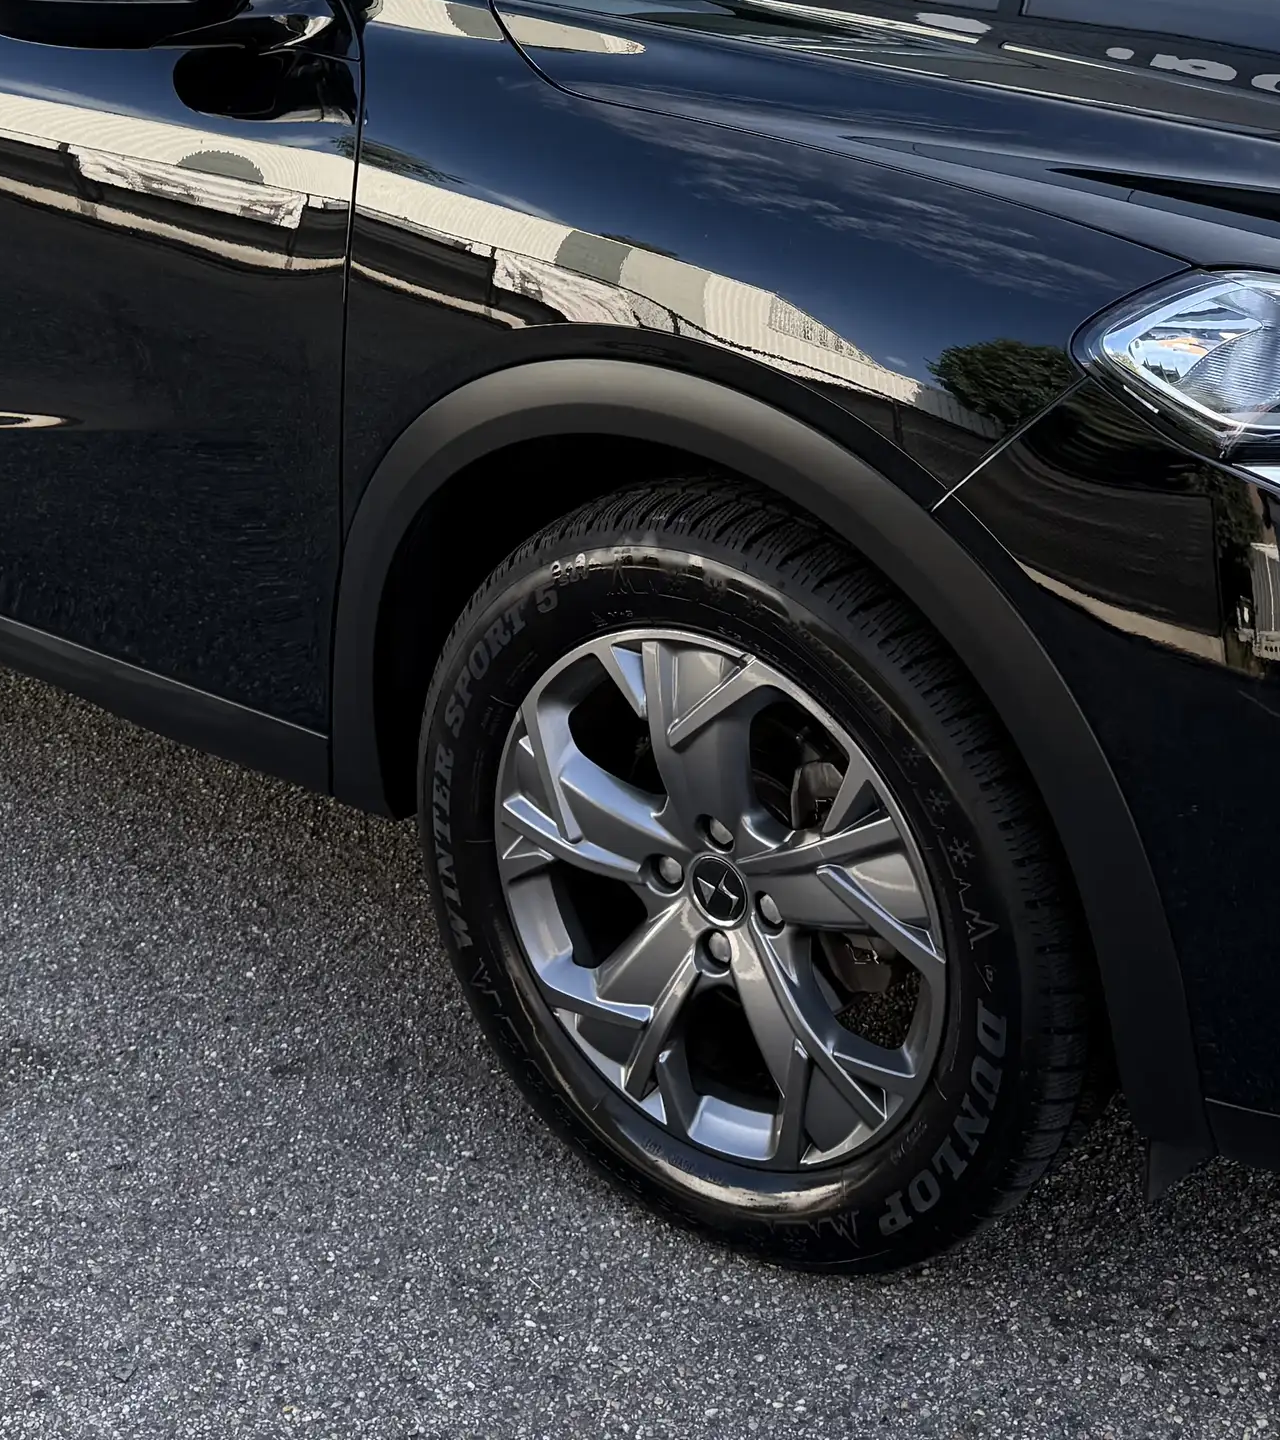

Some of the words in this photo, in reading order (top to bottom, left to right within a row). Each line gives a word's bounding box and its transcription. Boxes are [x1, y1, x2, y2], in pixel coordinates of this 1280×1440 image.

[444, 598, 529, 739] SPORT
[535, 583, 560, 616] 5
[431, 743, 474, 950] WINTER
[877, 997, 1009, 1237] DUNLOP
